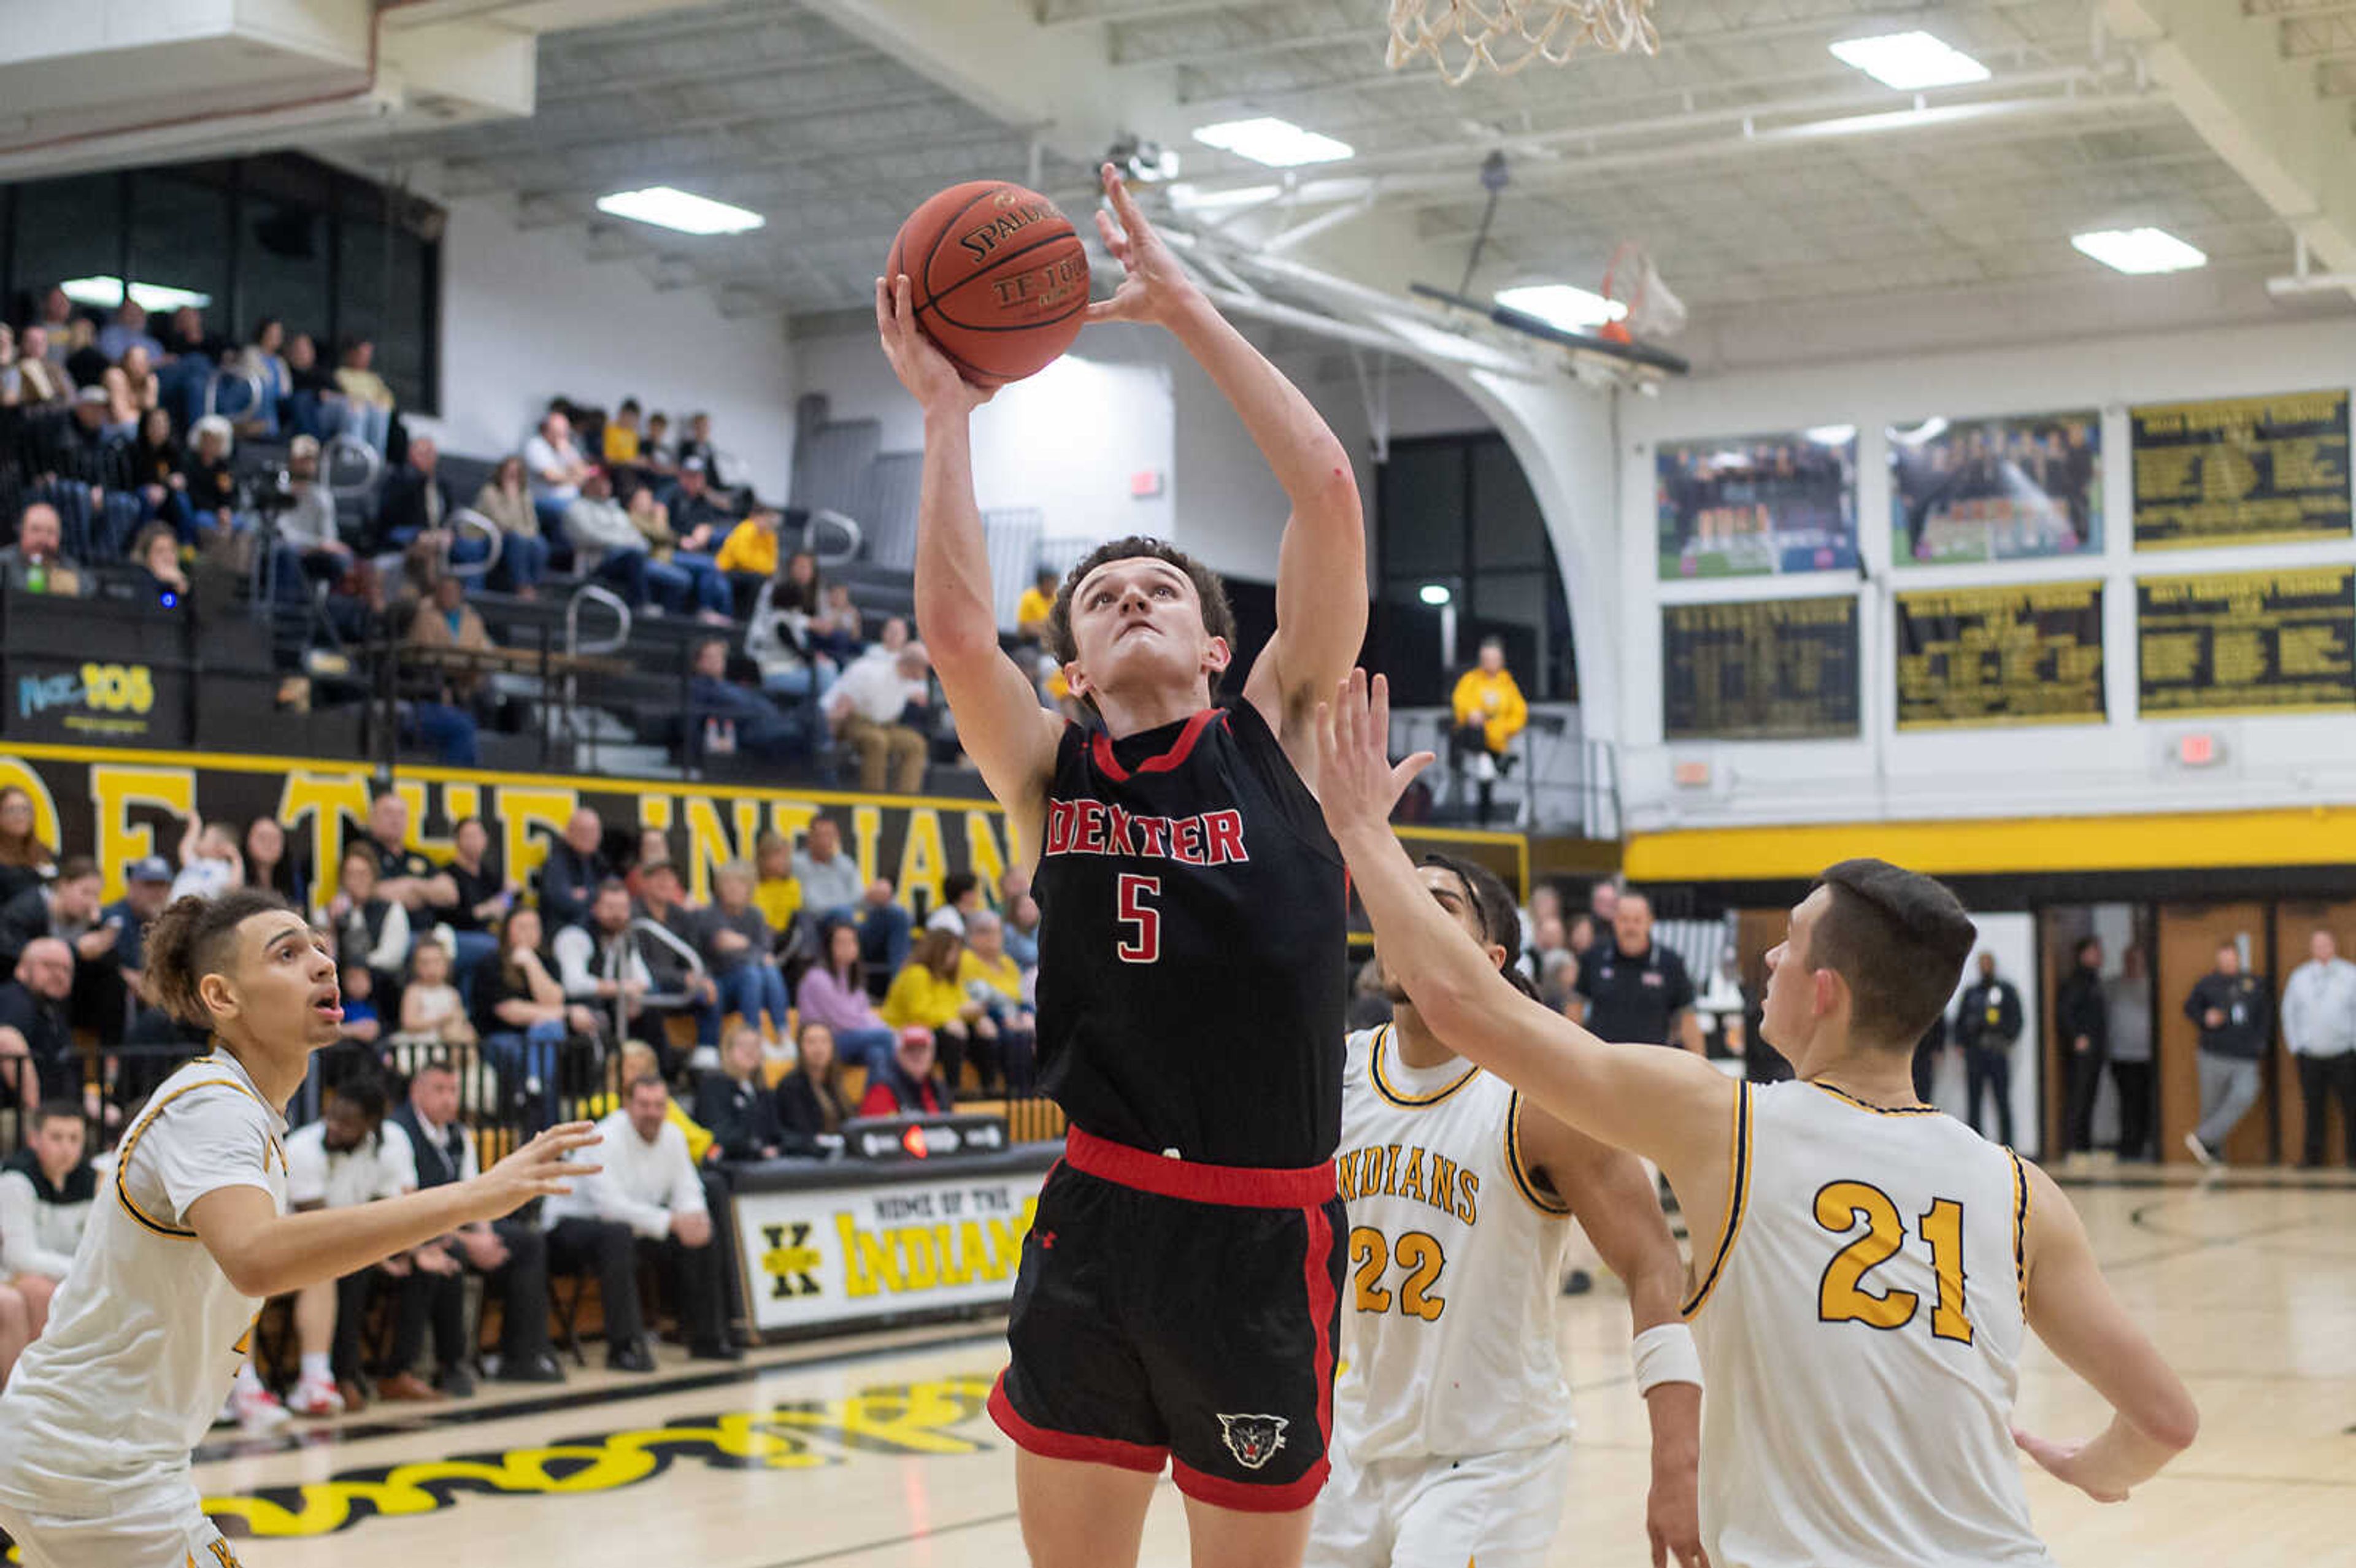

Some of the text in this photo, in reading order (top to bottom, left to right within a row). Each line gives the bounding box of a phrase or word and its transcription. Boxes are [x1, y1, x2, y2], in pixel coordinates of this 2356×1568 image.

[1045, 798, 1249, 866] DEXTER
[1117, 873, 1160, 963] 5
[1338, 1144, 1479, 1226] NDIANS
[835, 1196, 1038, 1299] INDIAN
[1349, 1226, 1446, 1321] 22
[1813, 1180, 1974, 1347] 21
